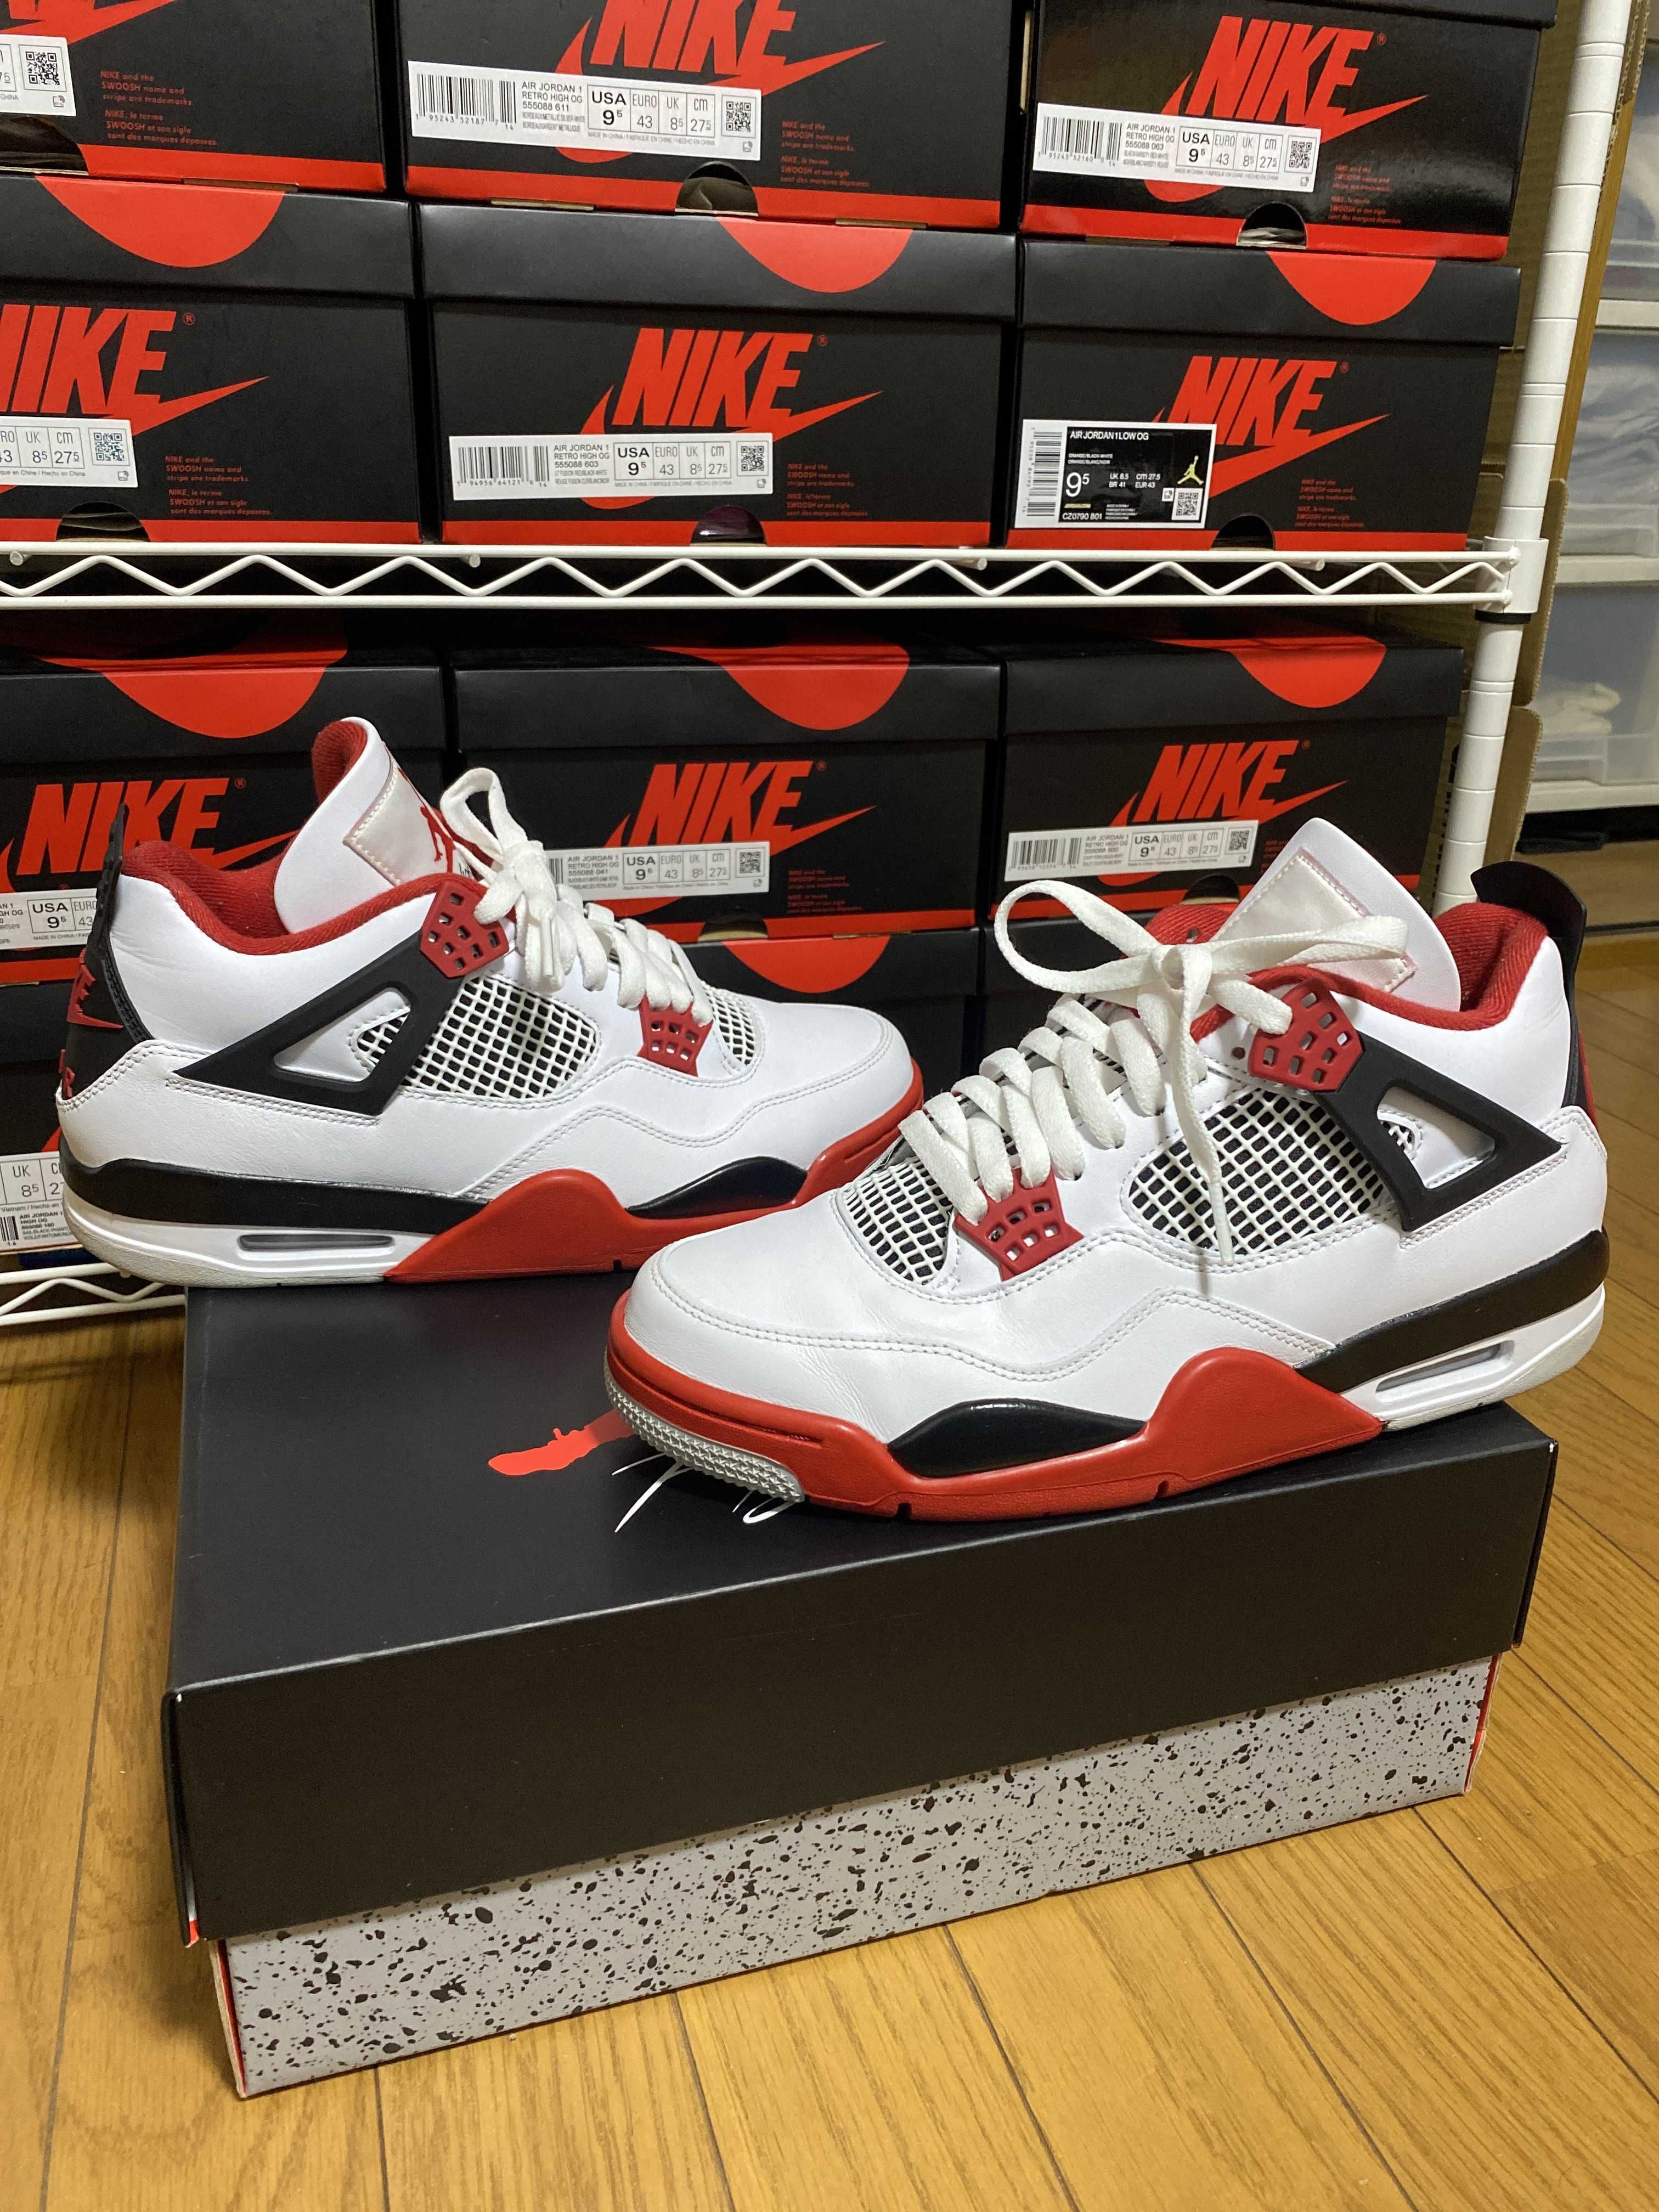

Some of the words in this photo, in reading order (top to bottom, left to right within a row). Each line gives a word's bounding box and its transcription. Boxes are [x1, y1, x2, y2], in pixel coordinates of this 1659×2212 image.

[590, 0, 797, 75] NIKE
[1185, 15, 1374, 121] NIKE
[102, 82, 141, 92] SWOOSH
[522, 82, 536, 91] AIR
[539, 83, 575, 93] JORDAN
[522, 92, 548, 101] RETRO
[550, 93, 569, 102] HIGH
[571, 95, 583, 104] OG
[591, 91, 627, 105] USA
[633, 94, 657, 108] EURO
[667, 97, 679, 110] UK
[522, 101, 553, 111] 555088
[555, 103, 569, 112] 611
[106, 121, 145, 130] SWOOSH
[637, 115, 653, 128] 43
[1141, 125, 1170, 133] JORDAN
[1126, 132, 1147, 140] RETRO
[1182, 132, 1210, 145] USA
[1215, 134, 1235, 147] EURO
[1243, 137, 1252, 149] UK
[1125, 140, 1149, 149] 555088
[1216, 153, 1229, 165] 43
[0, 304, 176, 414] IKE
[612, 328, 812, 427] NIKE
[1167, 356, 1336, 446] NIKE
[26, 432, 41, 444] UK
[1083, 431, 1114, 440] JORDAN
[1119, 432, 1136, 440] LOW
[1137, 432, 1149, 441] OG
[618, 447, 650, 458] USA
[655, 446, 678, 458] EURO
[686, 446, 698, 457] UK
[659, 464, 674, 475] 43
[1132, 740, 1299, 822] NIKE
[629, 761, 813, 847] NIKE
[16, 778, 230, 876] NIKE
[1135, 835, 1159, 845] USA
[1163, 833, 1181, 844] EURO
[1188, 833, 1198, 842] UK
[1164, 847, 1176, 856] 43
[627, 856, 656, 865] USA
[661, 855, 681, 864] EURO
[690, 854, 700, 863] UK
[665, 869, 678, 878] 43
[32, 902, 69, 913] USA
[78, 917, 93, 926] 43
[12, 1165, 31, 1178] UK
